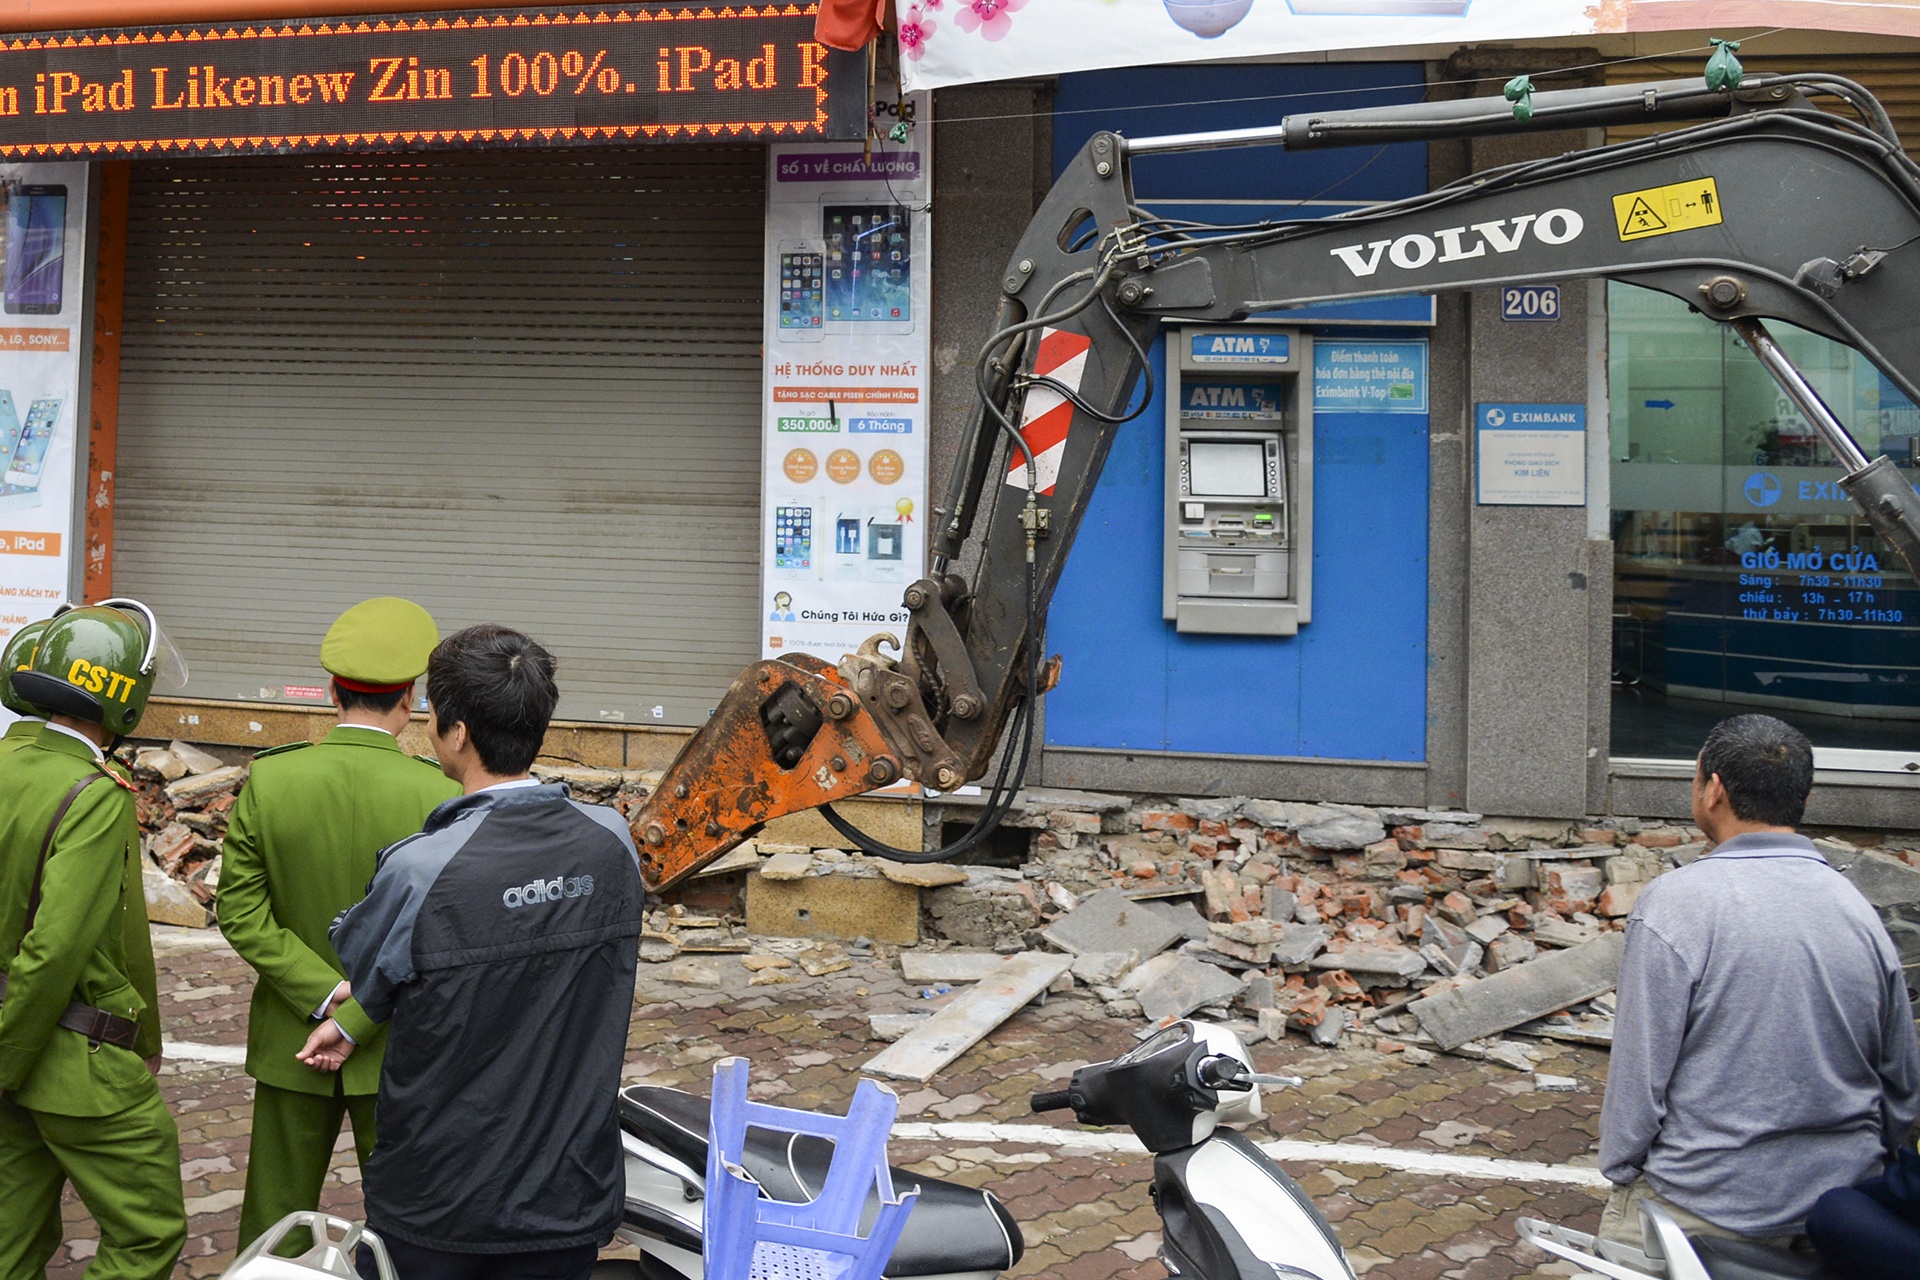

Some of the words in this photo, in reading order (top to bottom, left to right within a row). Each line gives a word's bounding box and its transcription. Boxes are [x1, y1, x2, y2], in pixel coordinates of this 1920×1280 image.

[35, 69, 135, 114] iPad
[151, 66, 355, 109] Likenew
[369, 57, 453, 101] Zin
[471, 49, 635, 98] 100%.
[657, 43, 777, 92] iPad
[875, 100, 915, 117] Pad
[781, 160, 799, 174] SỐ
[803, 164, 809, 173] 1
[1329, 207, 1585, 277] VOLVO
[1505, 290, 1557, 315] 206
[10, 335, 26, 346] LG,
[1211, 337, 1255, 353] ATM
[775, 362, 791, 378] HỆ
[796, 361, 844, 376] THỐNG
[849, 365, 875, 376] DUY
[880, 361, 917, 376] NHẤT
[818, 391, 841, 399] CABLE
[1189, 387, 1246, 406] ATM
[1316, 386, 1360, 398] Eximbank
[1361, 386, 1387, 401] V-Top
[1513, 412, 1576, 423] EXIMBANK
[858, 421, 866, 430] 6
[868, 420, 905, 432] Tháng
[14, 536, 46, 550] iPad
[1786, 545, 1823, 571] MỞ
[1829, 545, 1878, 571] CỬA
[1739, 573, 1772, 588] Sáng
[19, 587, 43, 598] XÁCH
[44, 589, 61, 599] TAY
[1802, 592, 1825, 604] 13h
[801, 610, 839, 622] Chúng
[842, 611, 859, 620] Tôi
[862, 612, 885, 622] Hứa
[889, 613, 909, 622] Gì?
[67, 658, 136, 704] CSTT
[503, 875, 595, 908] adidas
